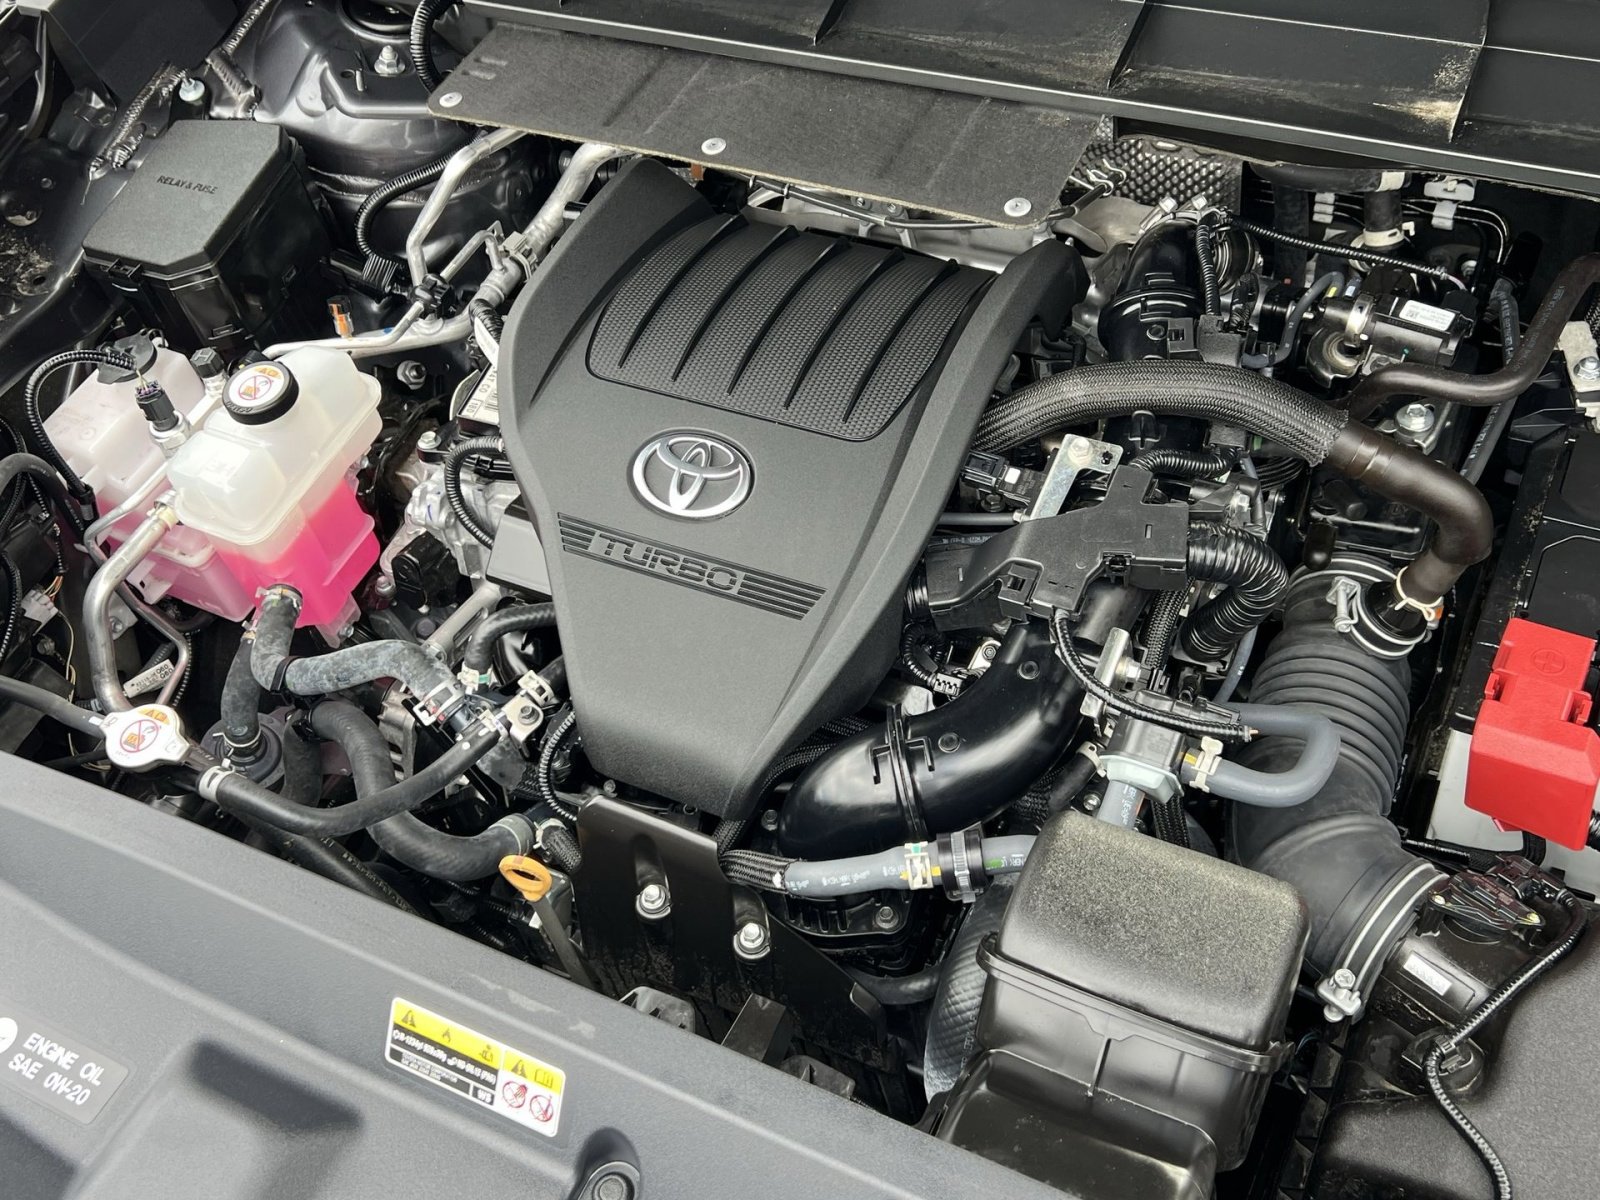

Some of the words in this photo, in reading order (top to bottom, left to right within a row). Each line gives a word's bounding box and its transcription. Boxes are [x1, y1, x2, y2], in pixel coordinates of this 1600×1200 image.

[156, 175, 186, 188] RELAY
[193, 183, 218, 195] FUSE
[598, 532, 738, 591] TURBO
[8, 1053, 44, 1080] SAE
[43, 1071, 91, 1105] 0W-20
[23, 1032, 80, 1071] ENGINE
[79, 1062, 105, 1086] OIL
